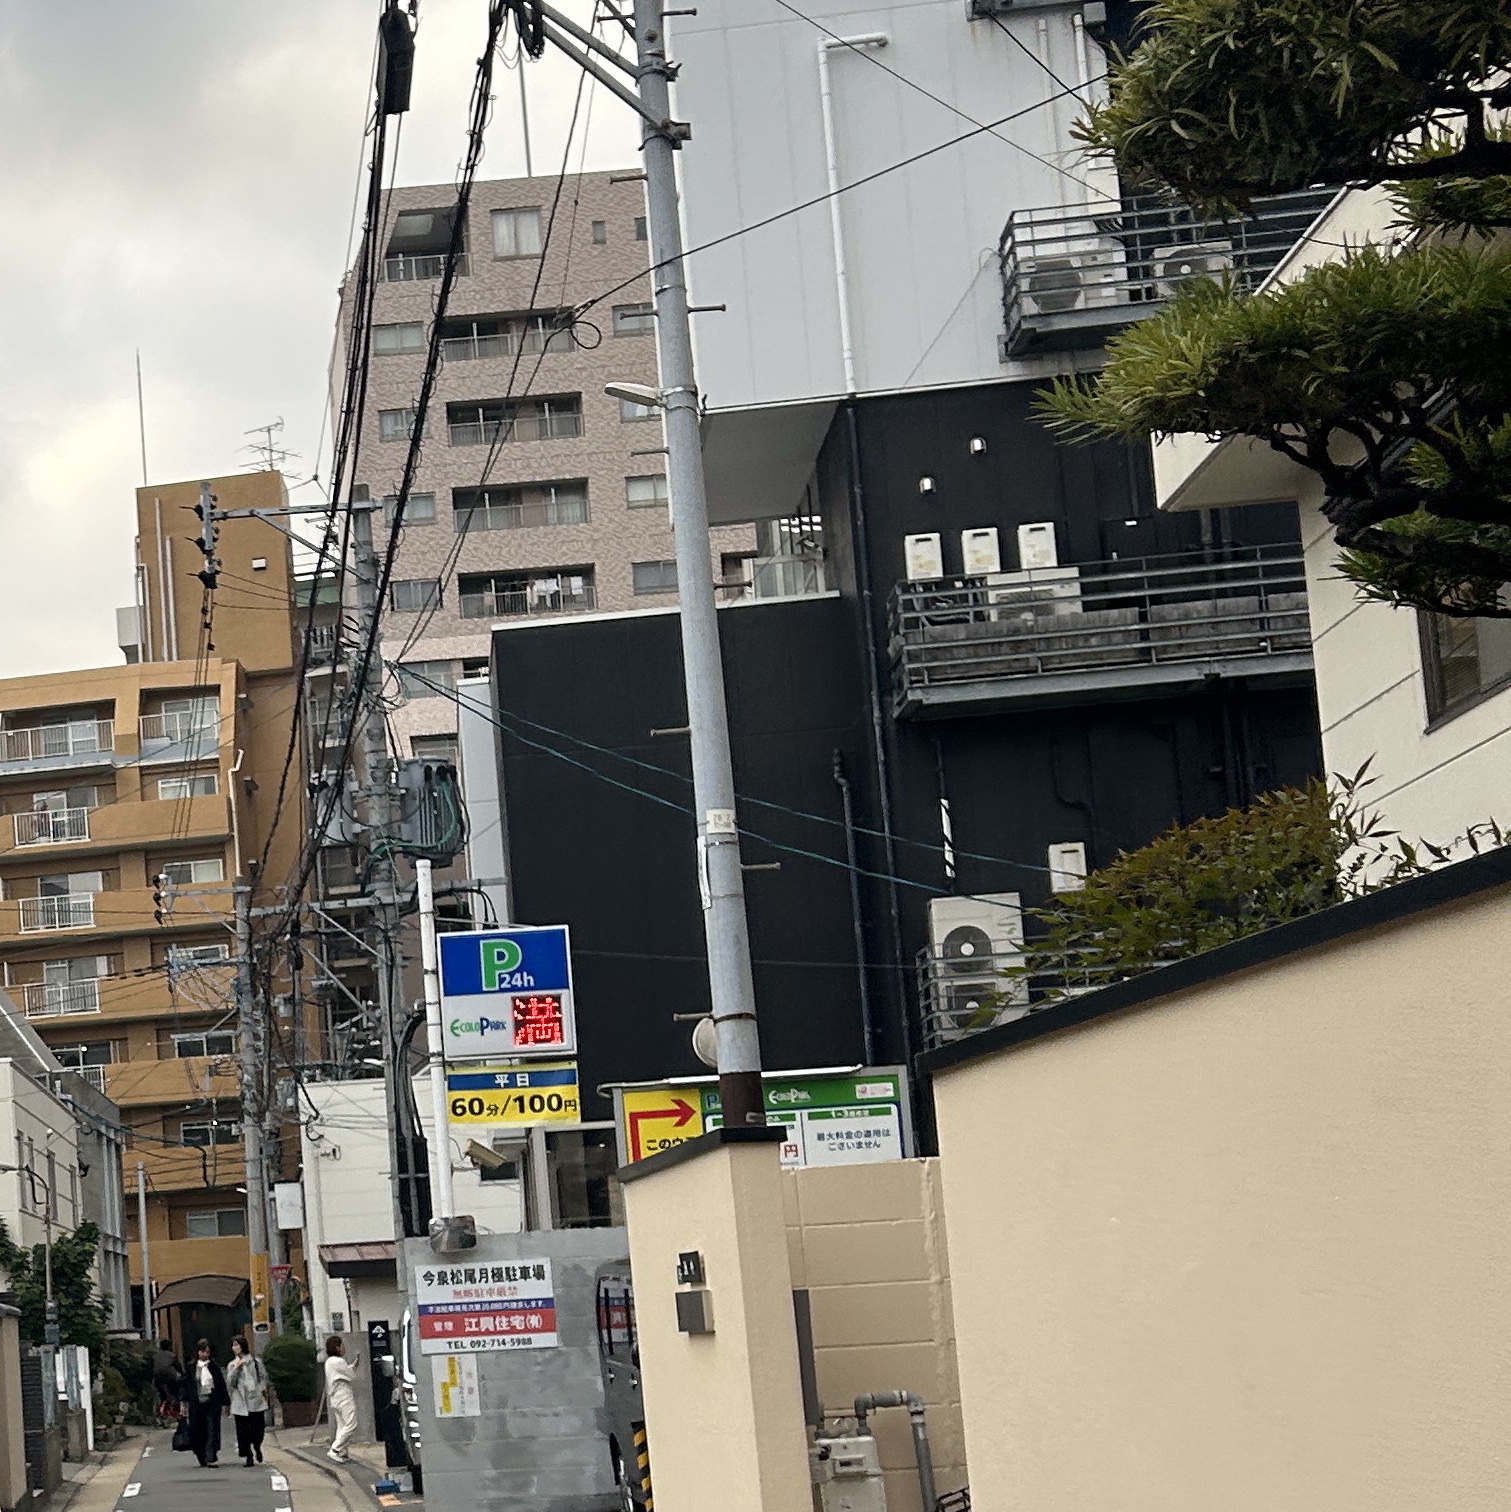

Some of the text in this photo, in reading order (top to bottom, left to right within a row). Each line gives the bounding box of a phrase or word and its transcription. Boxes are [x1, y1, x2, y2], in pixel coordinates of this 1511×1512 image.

[480, 938, 522, 992] P
[500, 972, 535, 988] 24h
[513, 997, 563, 1046] 満
[494, 1073, 530, 1088] 平日
[451, 1093, 577, 1117] 60分/100円
[423, 1264, 545, 1286] 今泉松尾月極駐車場
[447, 1340, 467, 1349] TEL
